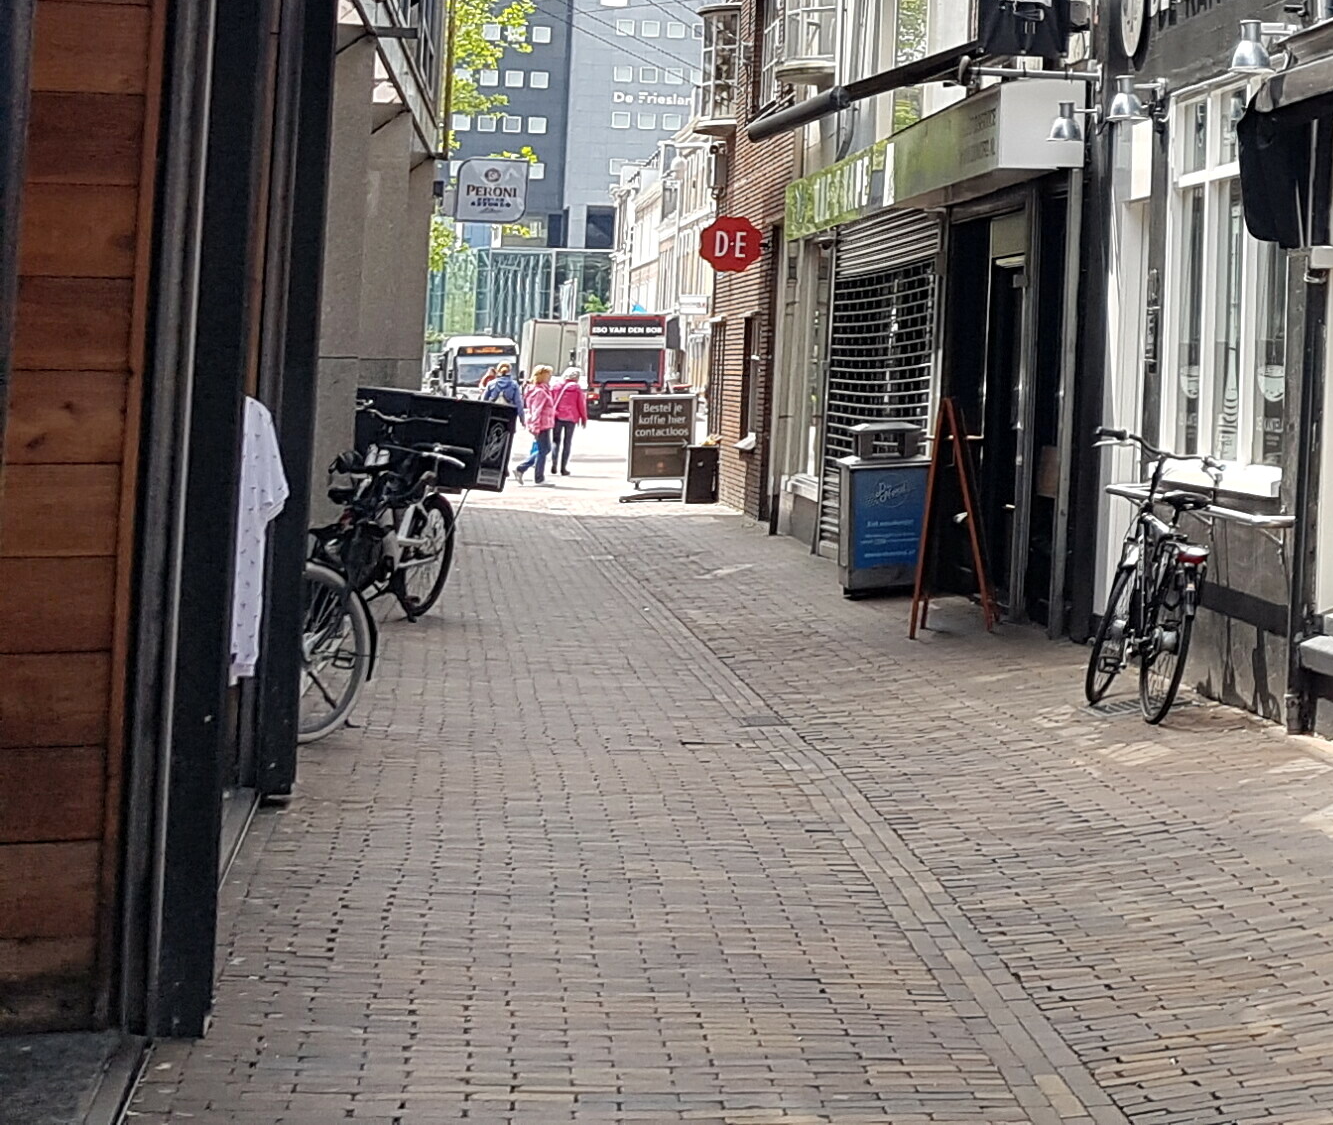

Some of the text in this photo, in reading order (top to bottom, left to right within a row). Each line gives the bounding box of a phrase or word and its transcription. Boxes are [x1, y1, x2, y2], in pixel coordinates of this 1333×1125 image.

[613, 91, 692, 106] De Frieslan
[466, 184, 517, 198] PERONI
[643, 402, 683, 416] Bestel je
[638, 415, 686, 425] koffie hier
[634, 426, 690, 437] contactloos
